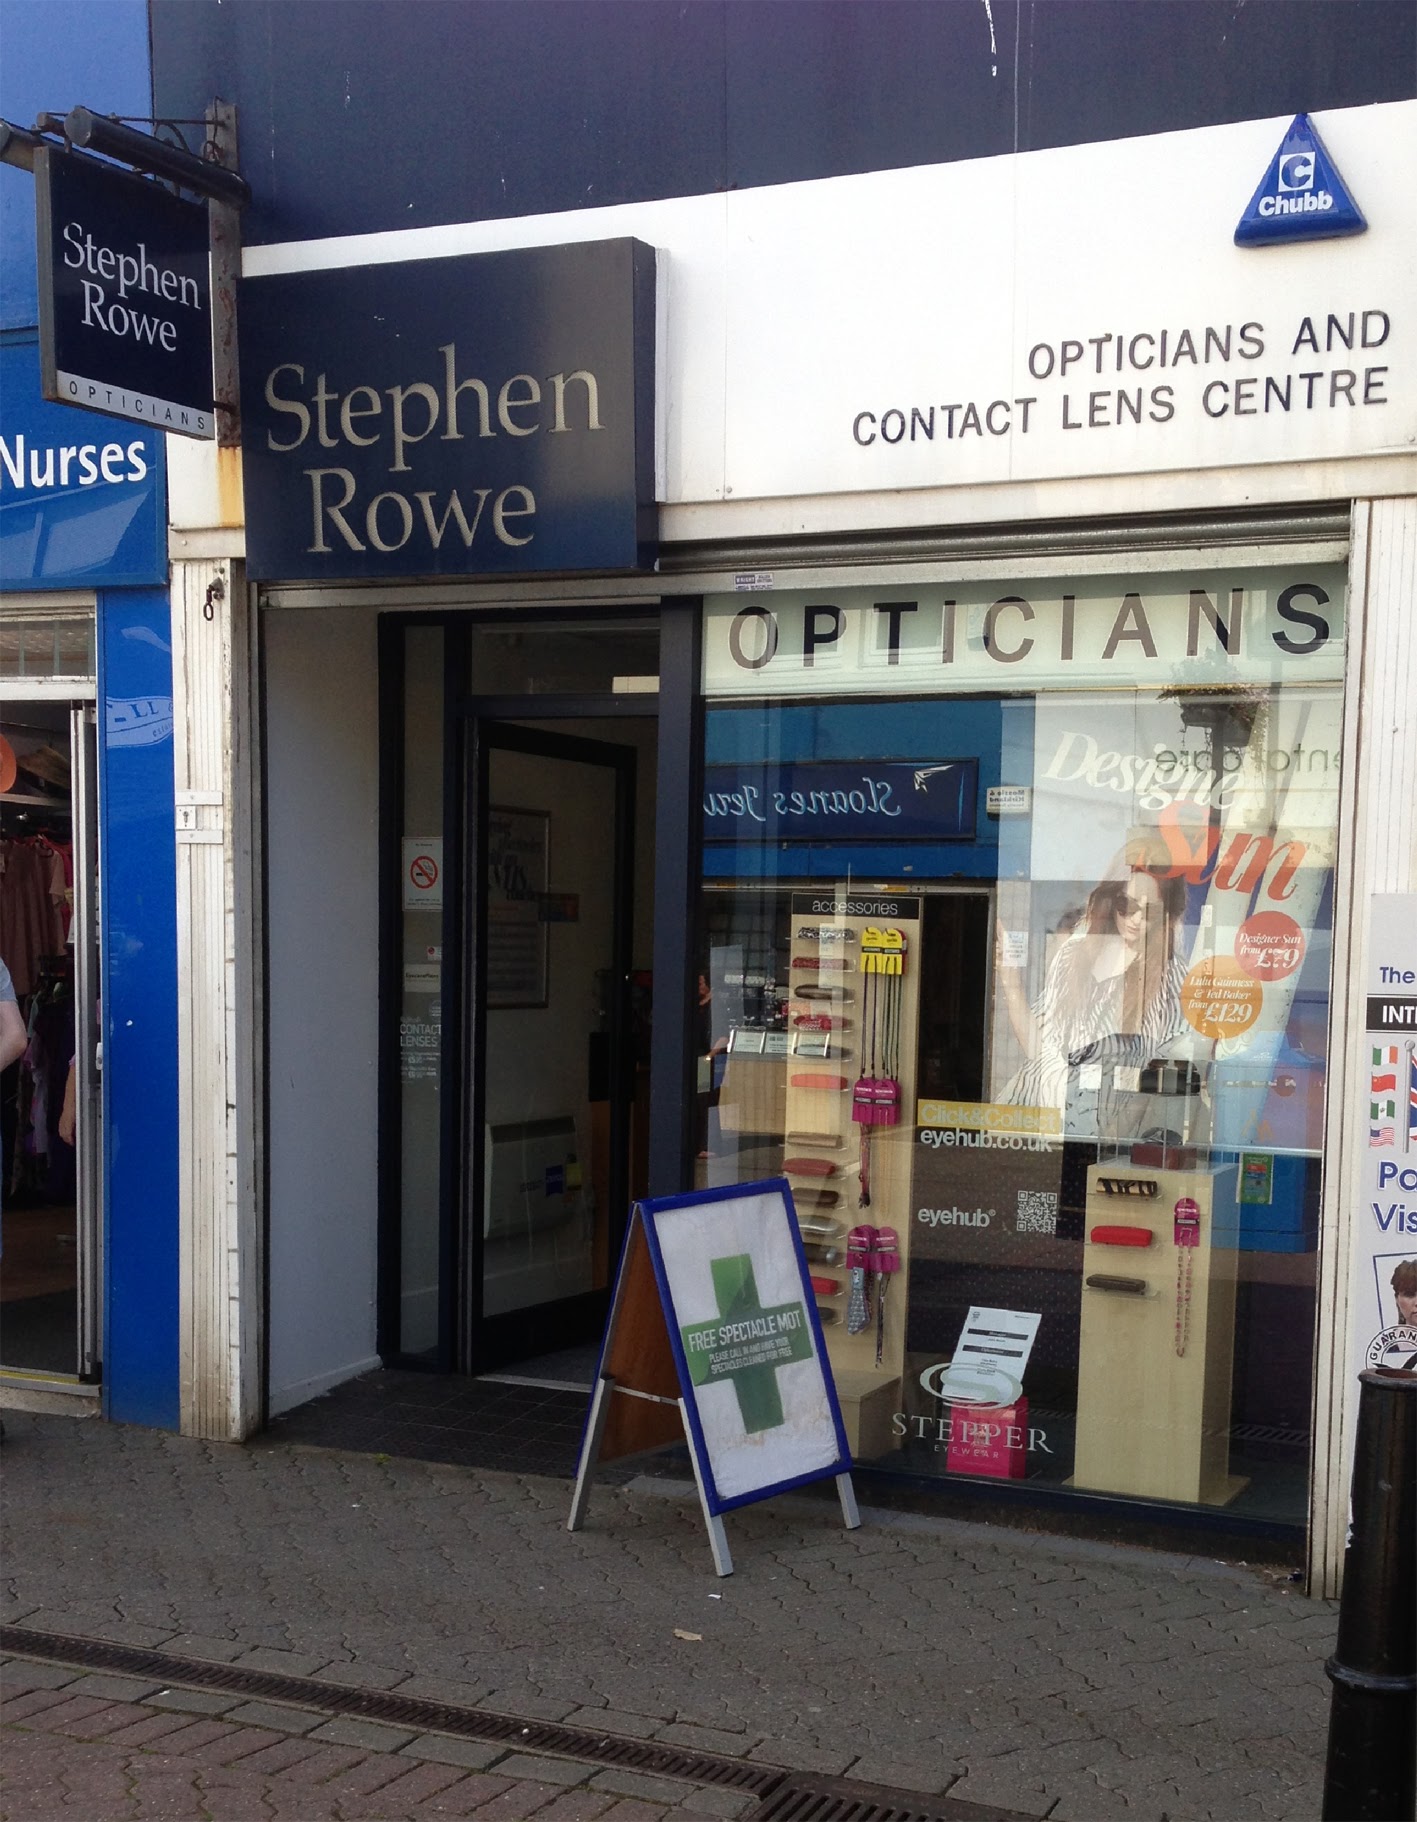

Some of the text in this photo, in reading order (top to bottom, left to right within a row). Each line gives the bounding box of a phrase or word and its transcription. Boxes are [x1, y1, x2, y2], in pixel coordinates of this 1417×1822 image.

[1259, 190, 1333, 216] Chubb
[63, 222, 201, 310] Stephen
[80, 279, 177, 352] Rowe
[1028, 309, 1391, 379] OPTICIANS AND
[69, 381, 205, 430] OPTICIANS
[264, 343, 606, 472] Stephen
[852, 366, 1389, 446] CONTACT LENS CENTRE
[0, 434, 147, 489] Nurses
[302, 466, 537, 553] Rowe
[728, 583, 1331, 670] OPTICIANS
[1131, 800, 1308, 901] Sun
[812, 900, 898, 916] accessories
[1239, 933, 1301, 945] Designer Sun
[1239, 945, 1300, 968] from £79
[1379, 966, 1416, 984] The
[1207, 988, 1222, 999] Ted
[1223, 989, 1252, 1000] Baker
[1188, 1000, 1253, 1024] from £129
[400, 1024, 442, 1035] CONTACT
[400, 1035, 438, 1047] LENSES
[921, 1104, 1057, 1131] Click&Collect
[920, 1128, 1053, 1152] eyehub.co.uk
[688, 1310, 801, 1353] FREE SPECTACLE MOT
[708, 1350, 729, 1363] PLEASE
[777, 1346, 793, 1357] FREE
[892, 1412, 1054, 1454] STEPPER
[934, 1444, 1000, 1459] EYEWEAR
